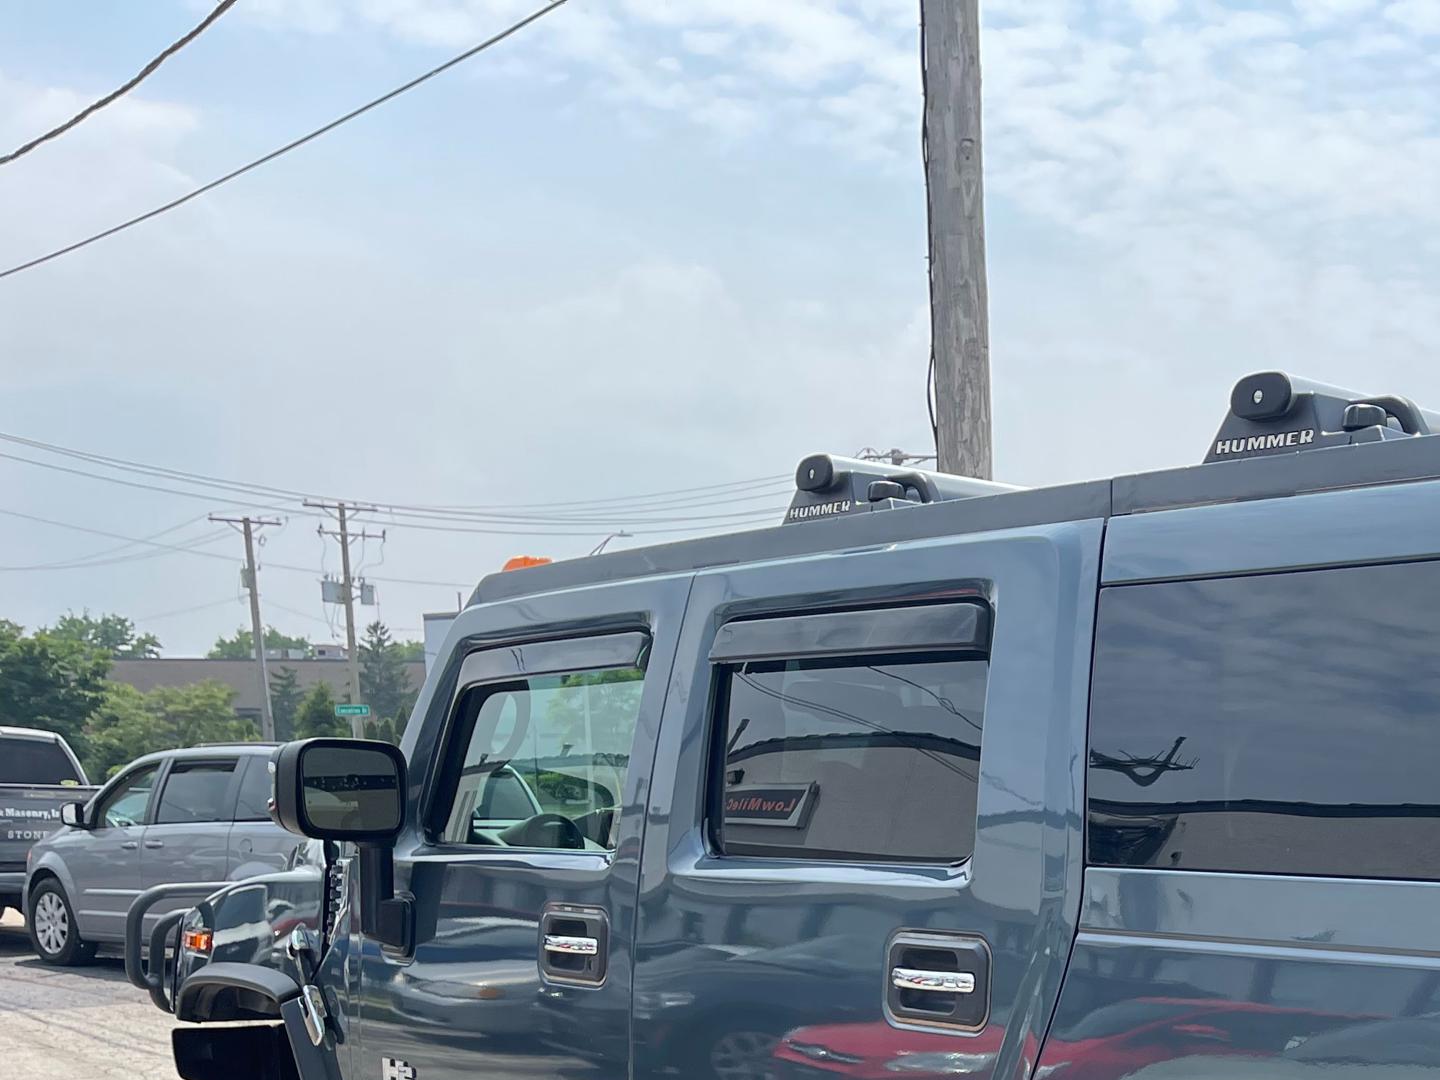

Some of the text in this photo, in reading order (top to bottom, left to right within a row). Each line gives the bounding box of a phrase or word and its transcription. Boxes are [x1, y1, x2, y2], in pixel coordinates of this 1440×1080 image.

[1215, 429, 1315, 455] HUMMER
[789, 500, 851, 519] HUMMER
[5, 808, 51, 820] Masonry,
